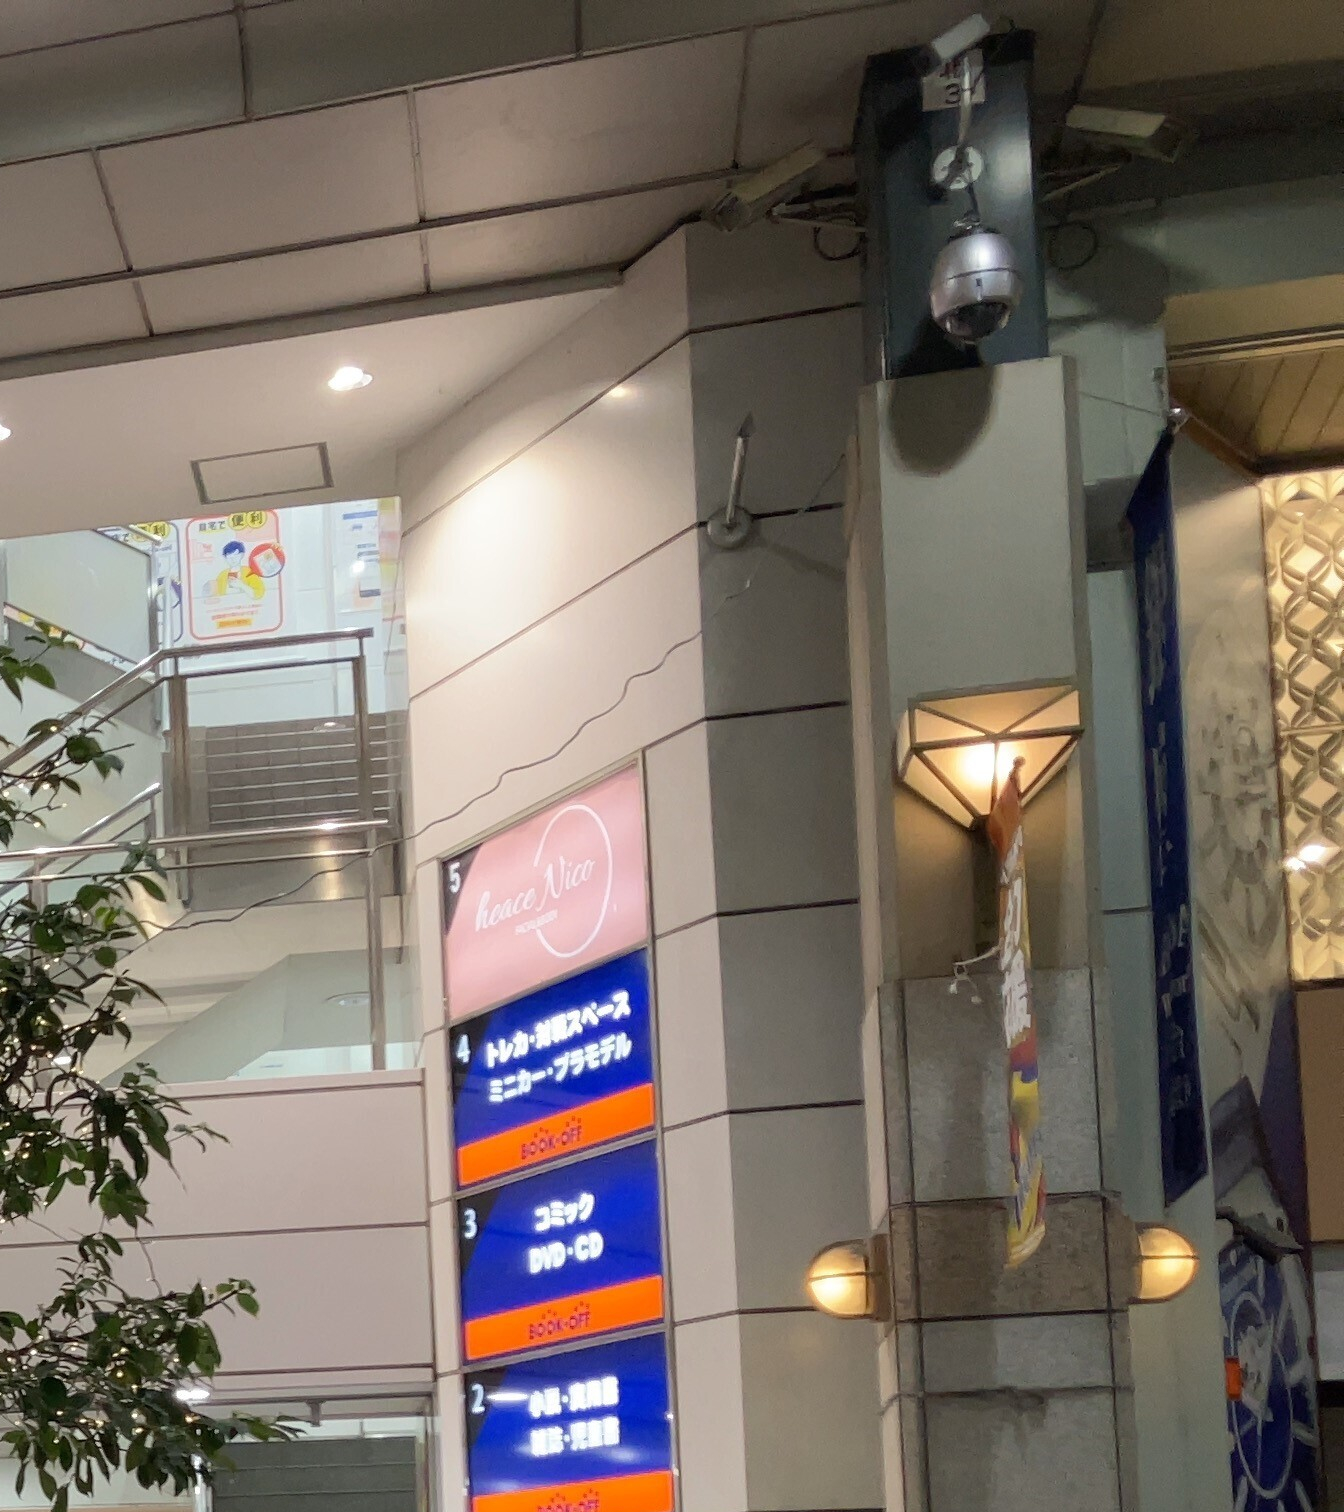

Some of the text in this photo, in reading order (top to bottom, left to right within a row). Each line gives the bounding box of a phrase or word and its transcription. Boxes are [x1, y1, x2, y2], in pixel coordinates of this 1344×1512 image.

[448, 861, 462, 895] 5
[535, 855, 596, 913] Nico
[455, 1033, 472, 1064] 4
[463, 1191, 597, 1240] 3 コミック
[470, 1382, 487, 1415] 2
